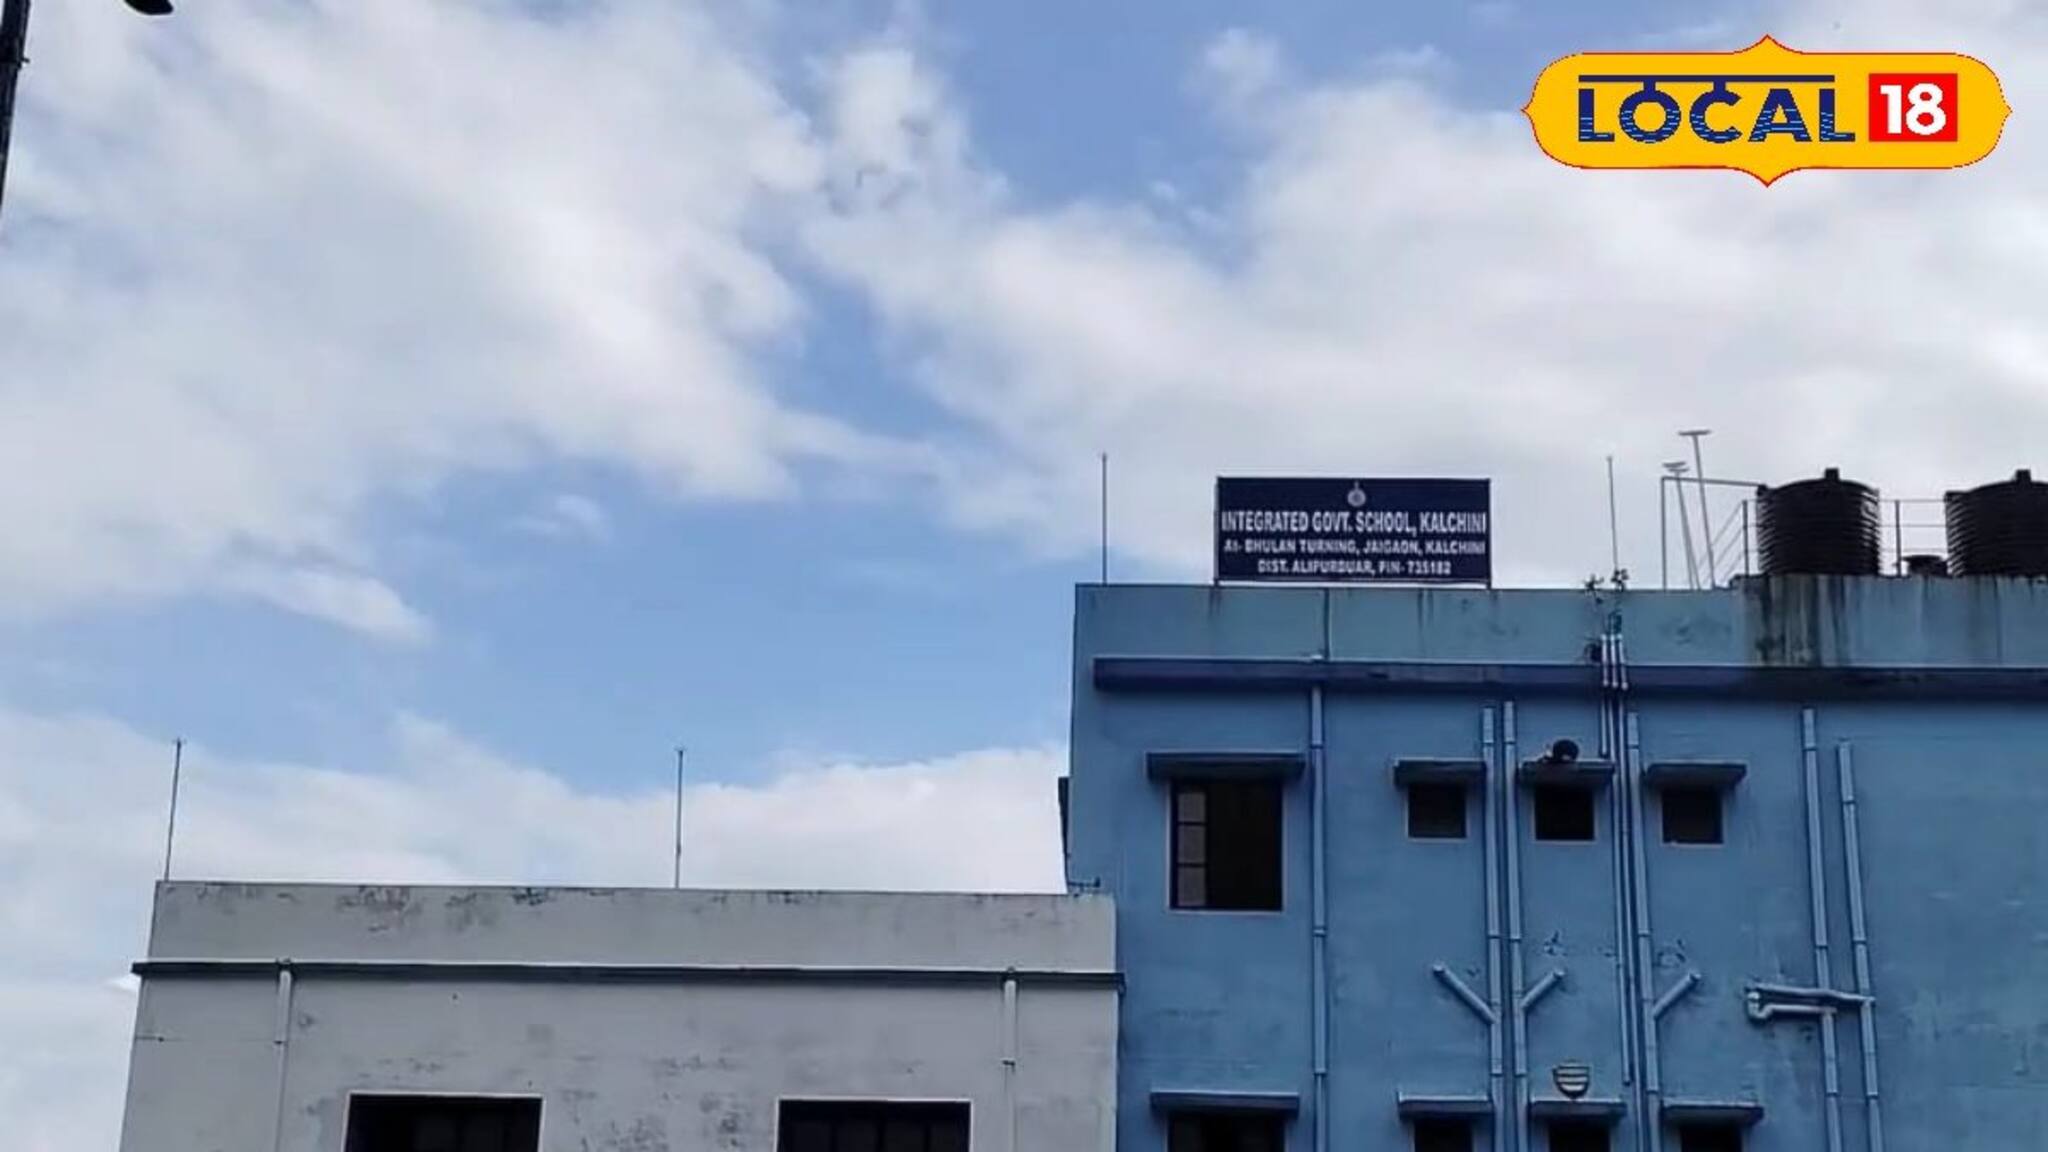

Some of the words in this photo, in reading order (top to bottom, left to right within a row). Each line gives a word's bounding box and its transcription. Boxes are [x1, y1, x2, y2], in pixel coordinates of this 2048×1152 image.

[1221, 511, 1309, 532] INTEGRATED
[1312, 511, 1353, 532] GOVT.
[1355, 511, 1417, 537] SCHOOL,
[1419, 511, 1487, 534] KALCHINI
[1299, 539, 1360, 556] TURNING,
[1363, 539, 1423, 556] JAIGAON,
[1425, 540, 1487, 554] KALCHINI
